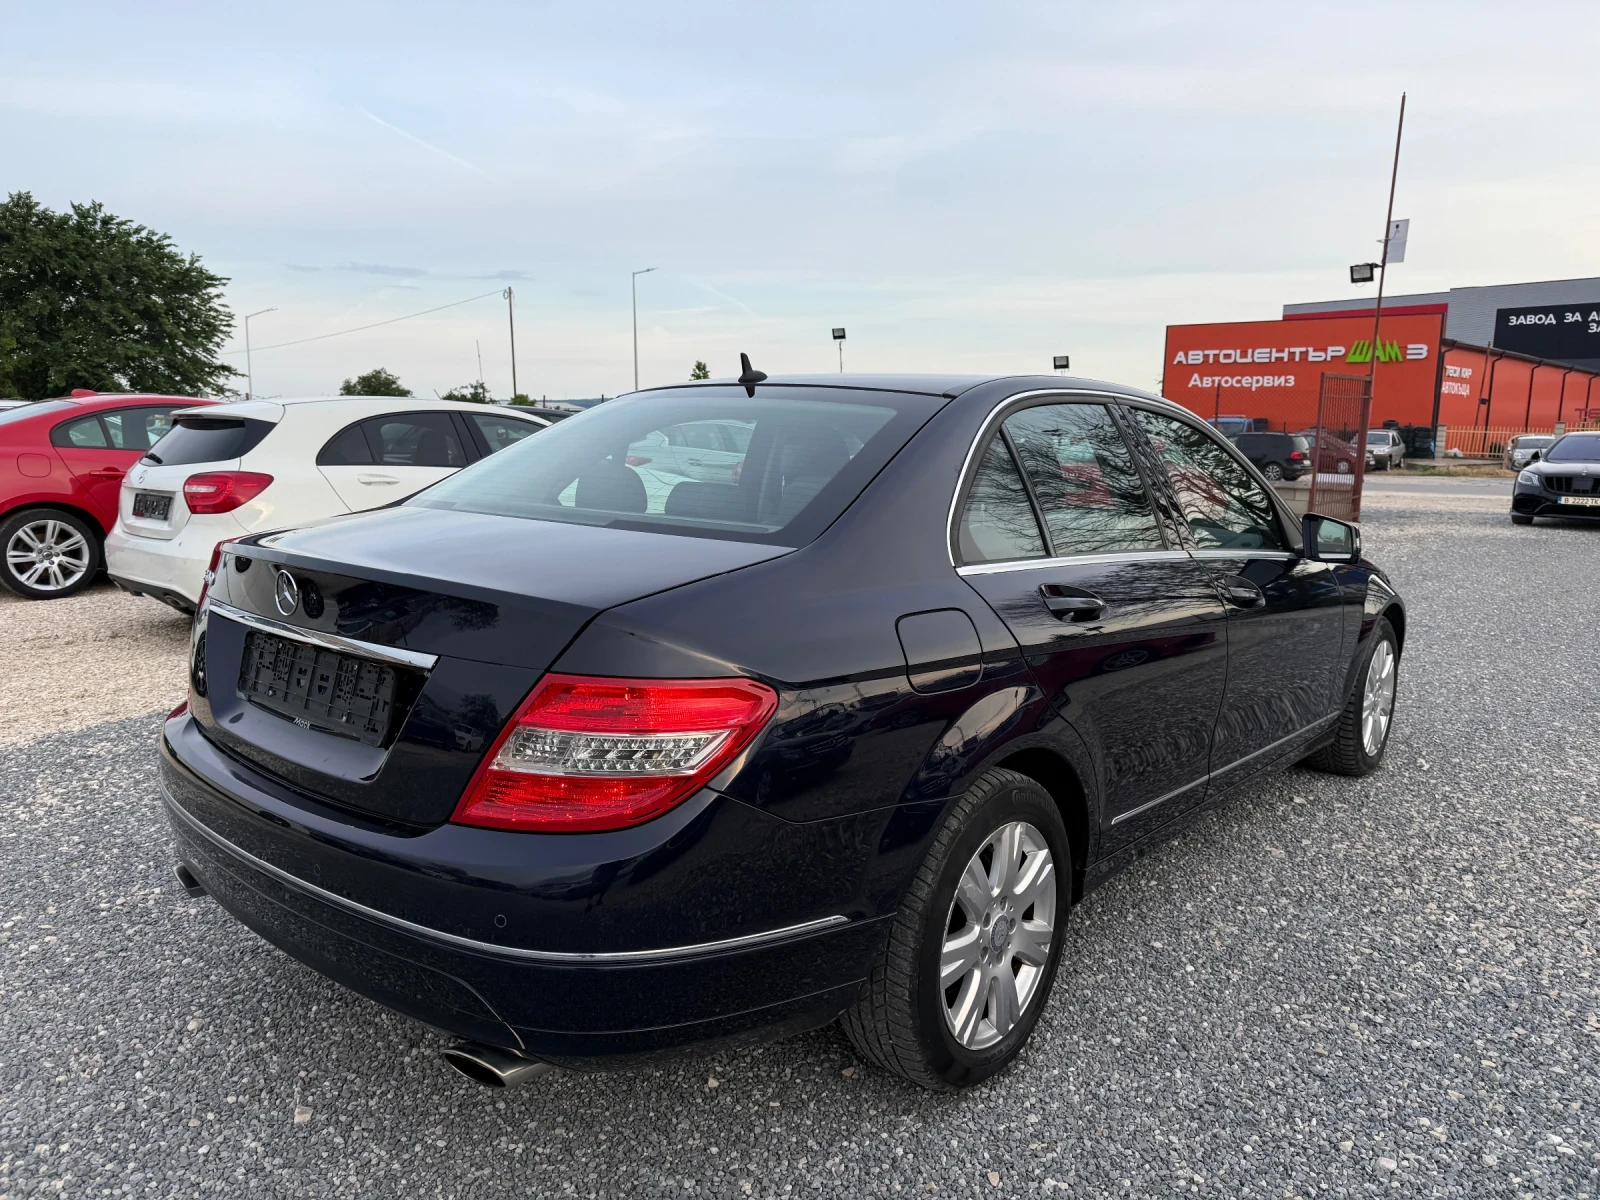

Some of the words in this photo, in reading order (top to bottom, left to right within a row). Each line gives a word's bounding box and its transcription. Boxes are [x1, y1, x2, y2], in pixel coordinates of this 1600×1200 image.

[1508, 313, 1556, 325] ЗАВОД
[1564, 311, 1582, 323] ЗА
[1588, 311, 1600, 321] А
[1173, 345, 1346, 365] АВТОЦЕНТЪР
[1345, 333, 1404, 363] ШАМ
[1188, 373, 1295, 391] Автосервиз
